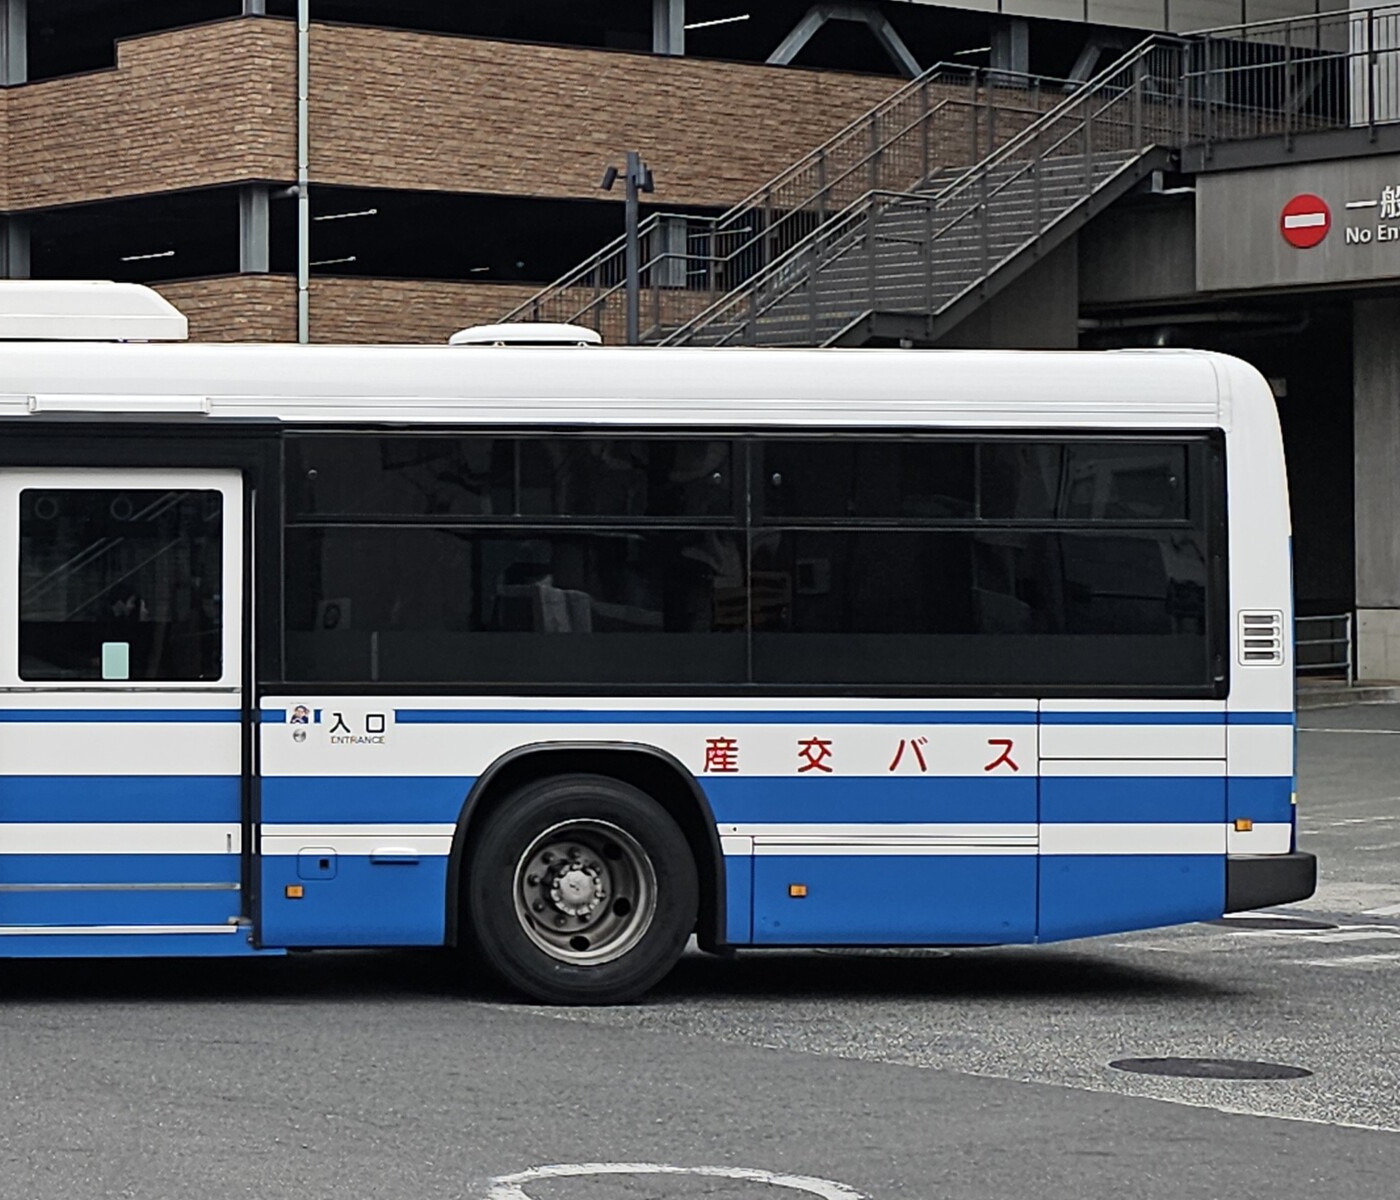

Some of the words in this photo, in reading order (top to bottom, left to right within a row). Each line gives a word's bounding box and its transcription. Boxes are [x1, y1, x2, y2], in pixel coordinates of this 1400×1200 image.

[1345, 226, 1372, 243] No
[1377, 224, 1400, 241] En
[329, 713, 385, 733] 入口
[330, 735, 385, 744] ENTRANCE
[703, 736, 1019, 773] 産交バス
